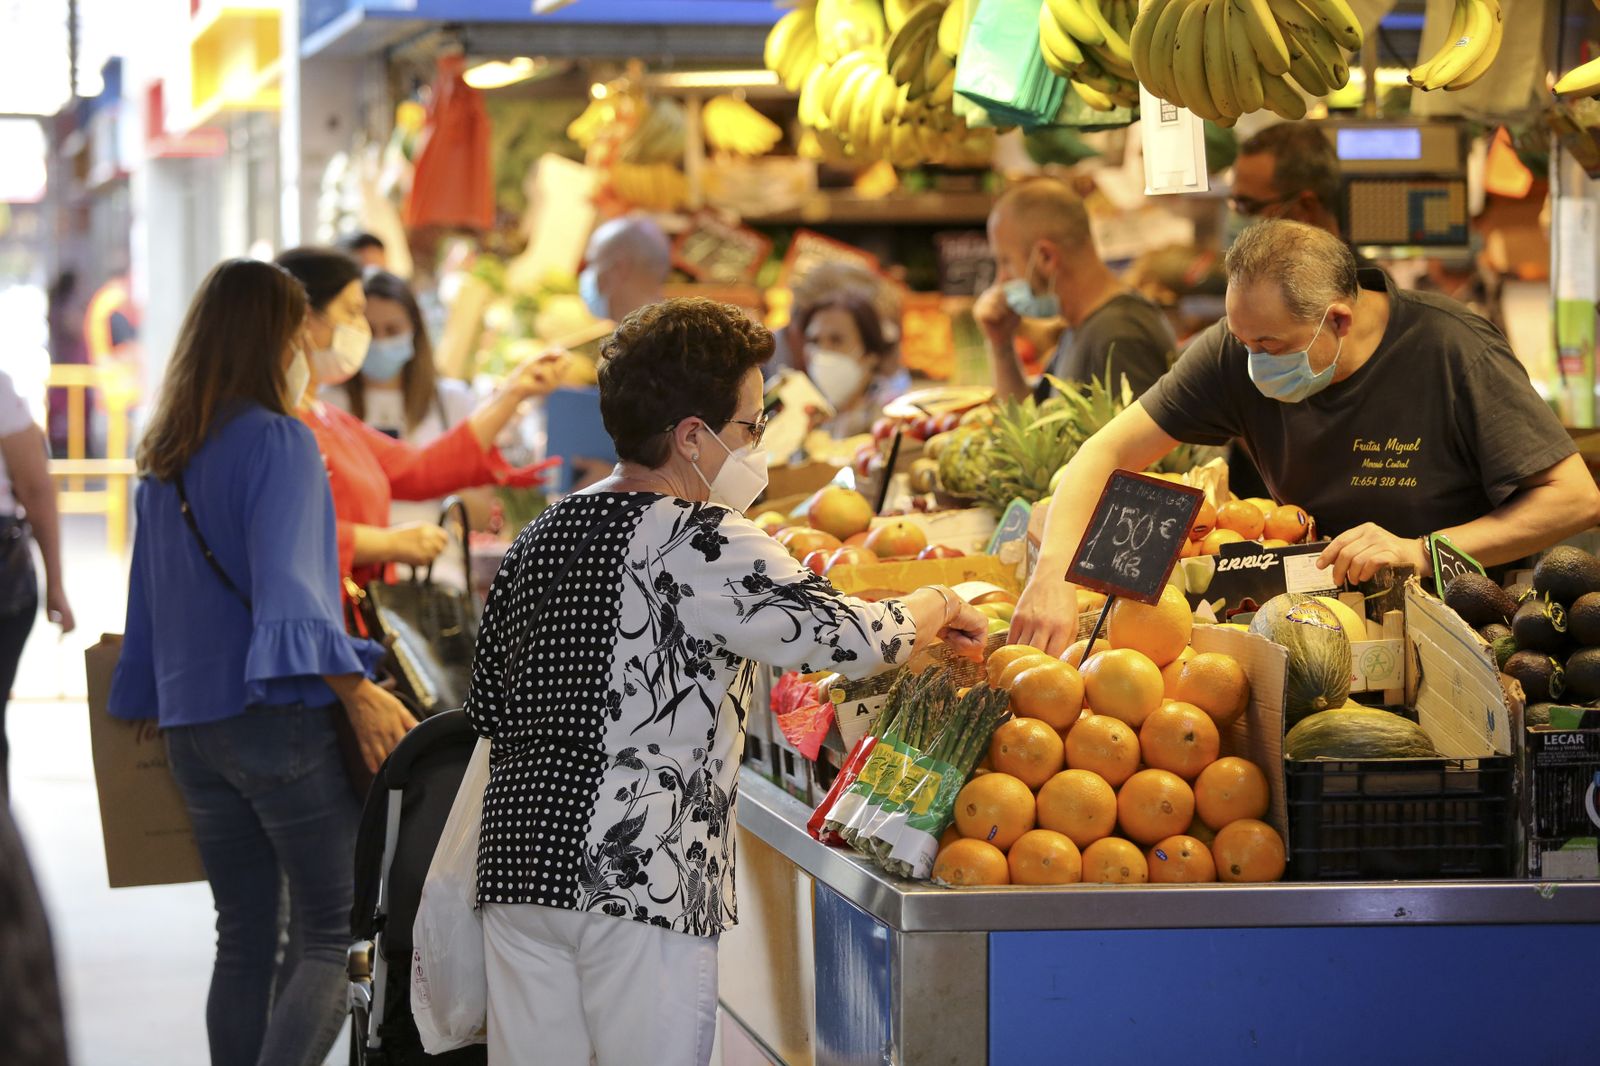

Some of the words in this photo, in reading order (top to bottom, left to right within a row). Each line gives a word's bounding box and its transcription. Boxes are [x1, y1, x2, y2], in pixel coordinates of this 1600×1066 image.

[1353, 438, 1381, 453] Frutas
[1384, 437, 1421, 455] Miguel
[1385, 458, 1410, 469] Central
[1379, 476, 1396, 487] 318
[1397, 476, 1417, 487] 446
[1544, 734, 1584, 745] LECAR
